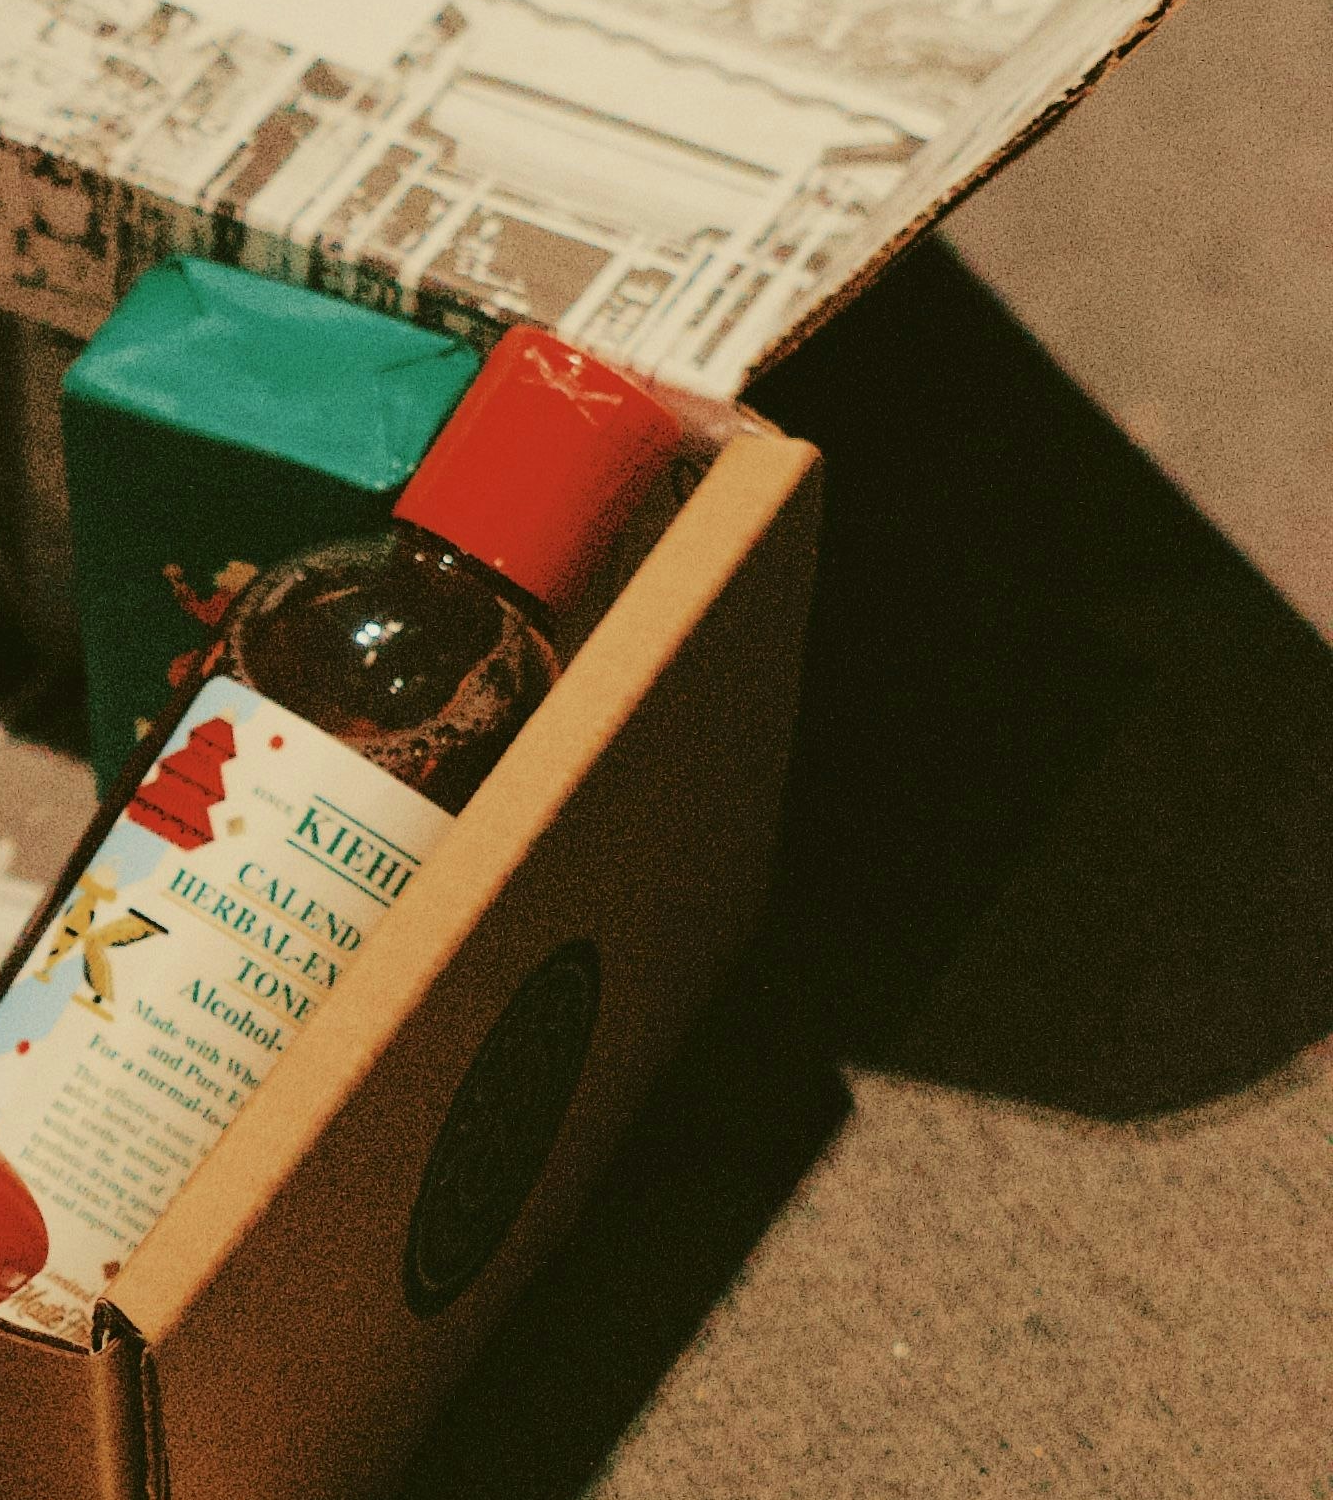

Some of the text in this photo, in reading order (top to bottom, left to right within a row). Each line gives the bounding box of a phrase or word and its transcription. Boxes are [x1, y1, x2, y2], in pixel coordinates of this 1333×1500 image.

[136, 1000, 180, 1040] Made
[185, 1035, 222, 1066] with
[181, 979, 285, 1052] Alcohol-
[89, 1032, 117, 1060] For
[147, 1045, 184, 1071] and
[184, 1063, 224, 1098] Pure
